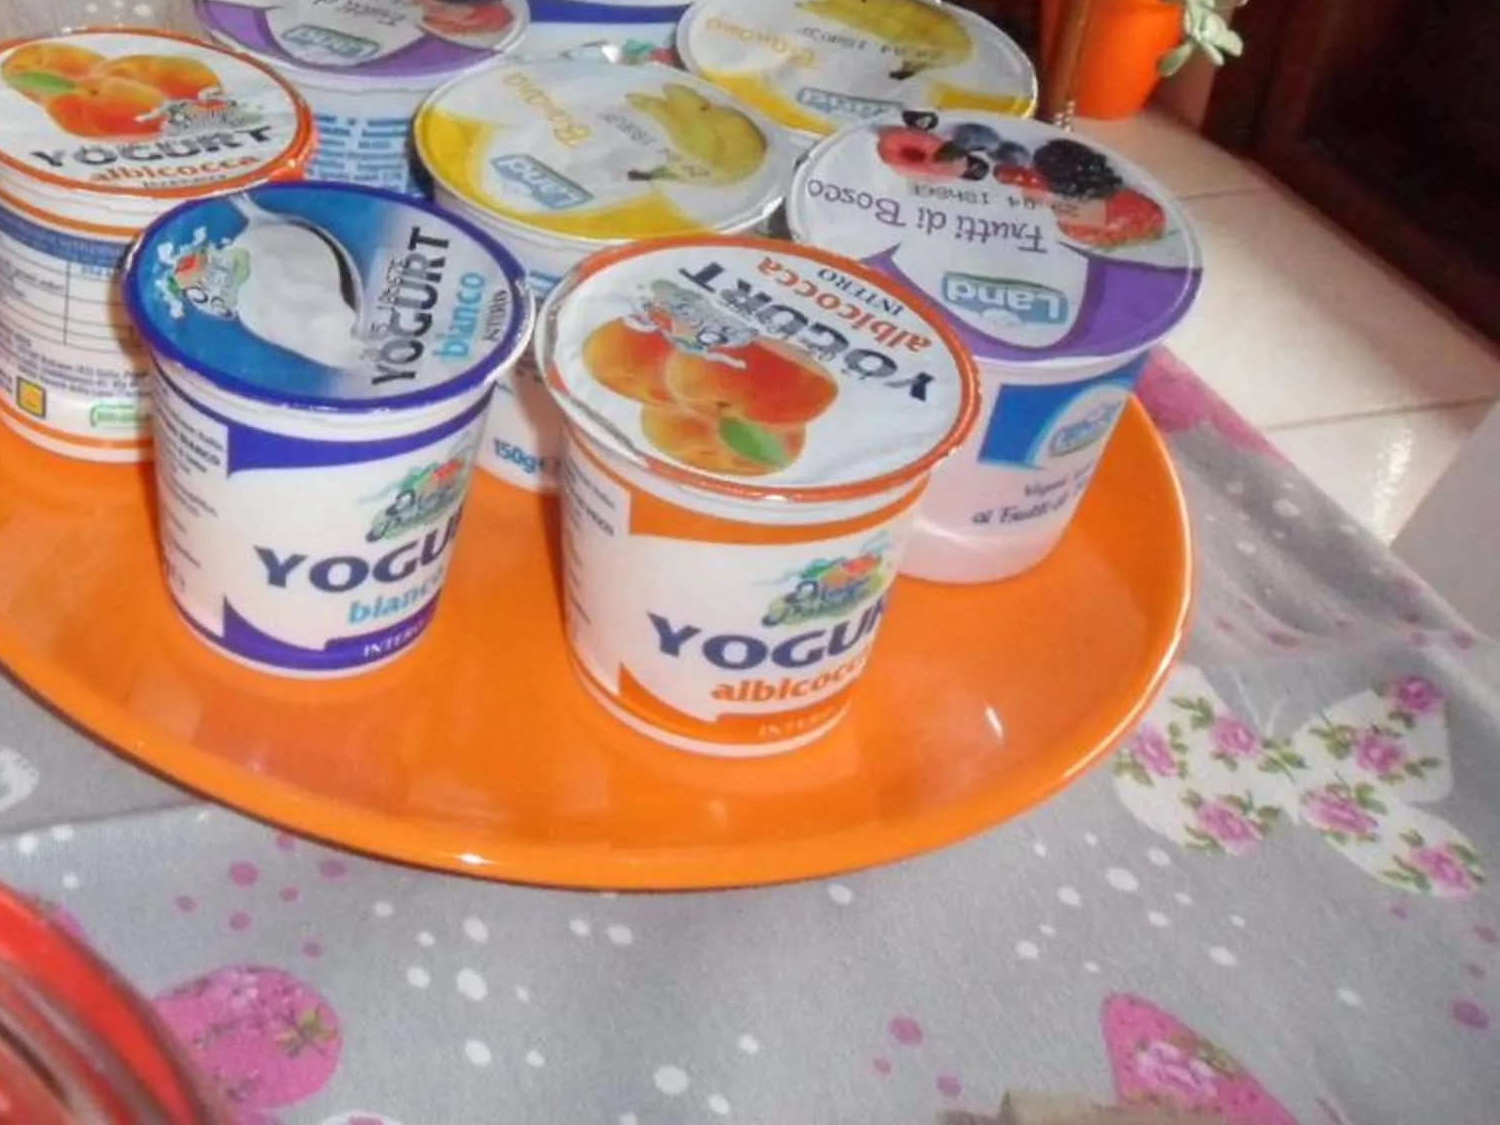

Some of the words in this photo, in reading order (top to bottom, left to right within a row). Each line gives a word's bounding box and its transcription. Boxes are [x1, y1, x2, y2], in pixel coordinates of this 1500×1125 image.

[30, 126, 272, 168] YOGURT
[89, 155, 260, 182] albicocca
[807, 177, 908, 227] Bosco
[918, 205, 948, 235] di
[957, 213, 1049, 255] Frutti
[372, 226, 450, 386] YOGURT
[432, 271, 486, 363] bianco
[756, 256, 933, 355] albicocca
[816, 267, 905, 317] INTERO
[946, 274, 1062, 322] Land
[678, 260, 937, 402] YOGURT
